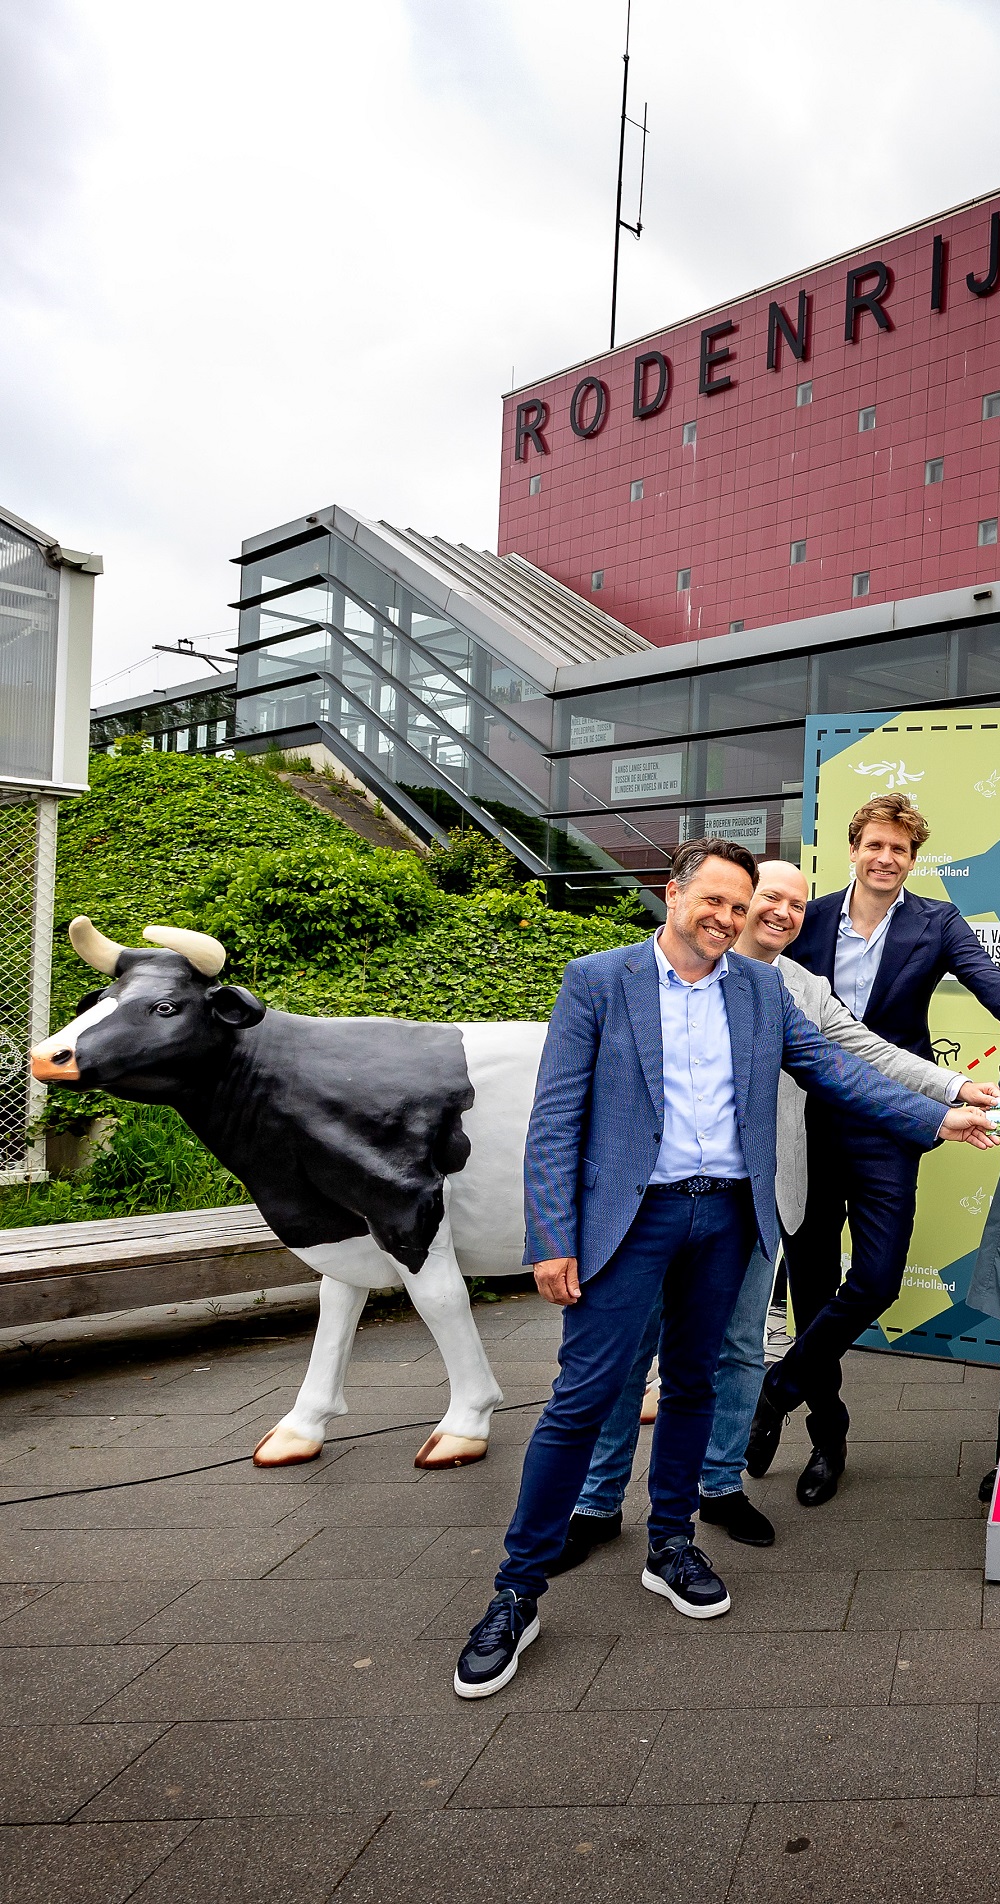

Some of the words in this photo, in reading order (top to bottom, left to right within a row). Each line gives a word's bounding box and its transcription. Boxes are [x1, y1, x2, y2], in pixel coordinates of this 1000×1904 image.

[615, 774, 630, 784] TUSSEN
[631, 773, 636, 782] DE
[641, 782, 657, 791] VOGELS
[663, 780, 669, 789] DE
[915, 853, 953, 863] ovincie
[908, 865, 970, 877] uid-Holland
